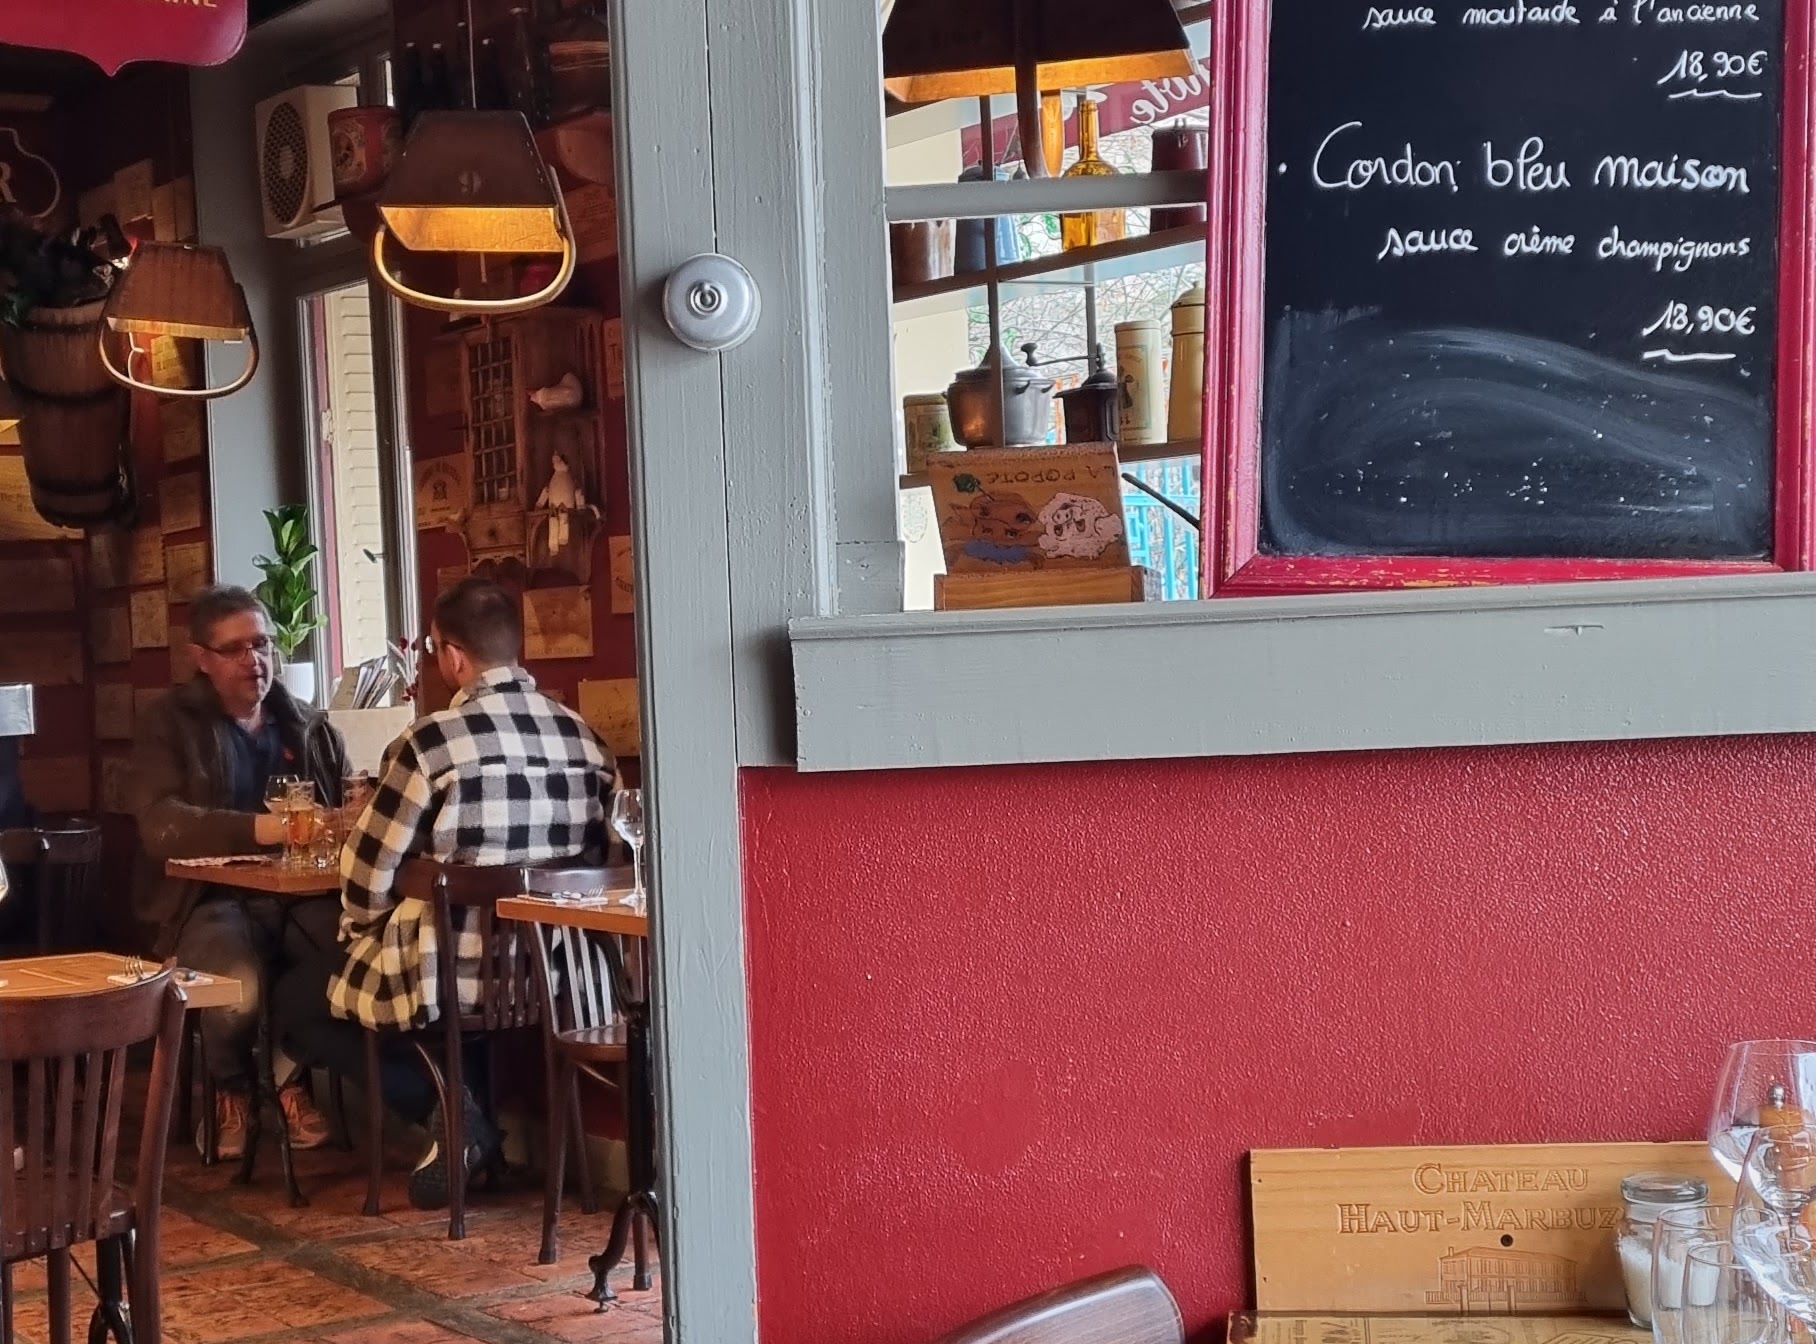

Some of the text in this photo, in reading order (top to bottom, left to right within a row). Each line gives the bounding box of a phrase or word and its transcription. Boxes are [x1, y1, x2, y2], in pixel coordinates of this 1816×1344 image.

[1362, 3, 1437, 31] sauce
[1313, 121, 1750, 194] Cordon bleu maison
[1378, 227, 1480, 261] sauce
[1599, 224, 1751, 272] champignons
[1412, 1162, 1589, 1195] CHATEAU
[1336, 1200, 1625, 1234] HAUT-MARBUZ
